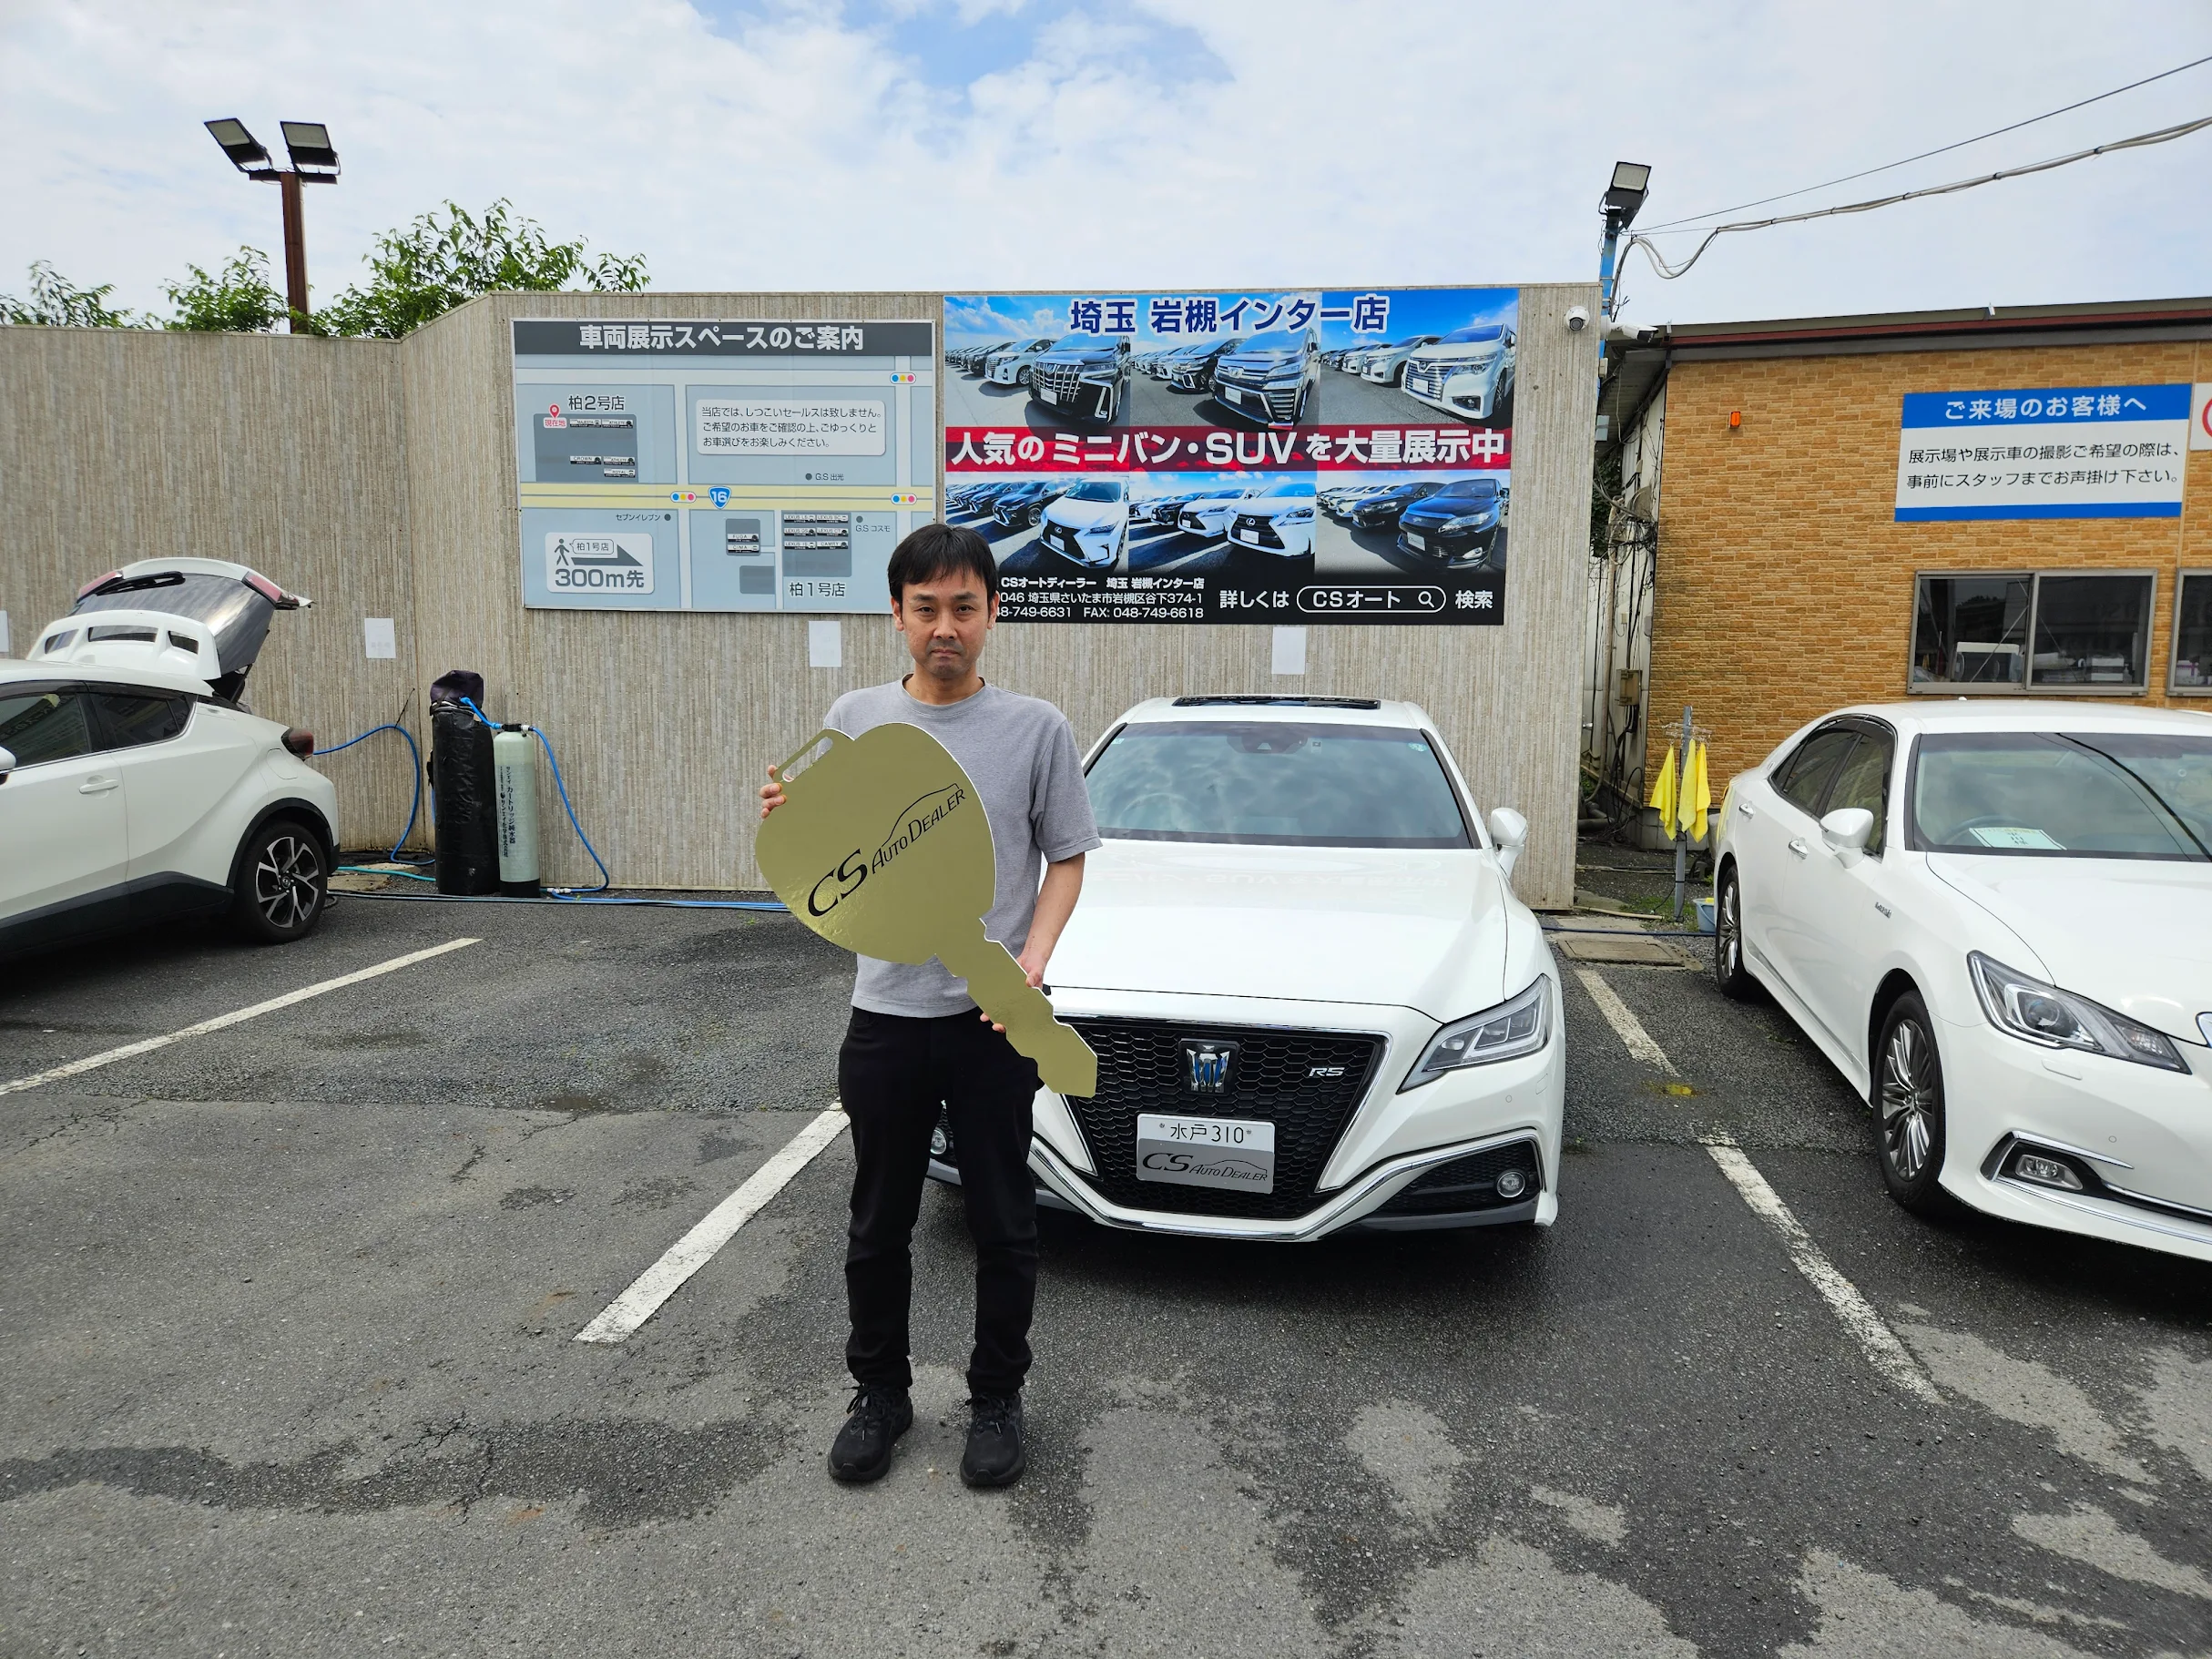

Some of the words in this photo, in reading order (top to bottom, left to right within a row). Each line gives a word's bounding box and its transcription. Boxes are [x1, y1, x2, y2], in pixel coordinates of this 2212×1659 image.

[1070, 301, 1137, 333] 埼玉
[1151, 296, 1389, 333] 岩槻インター店
[579, 324, 864, 351] 車両展示スペースのご案内
[568, 395, 625, 411] 柏2号店
[1945, 393, 2146, 420] ご来場のお客様へ
[701, 406, 882, 418] 当店では、しつこいセールスは致しません。
[545, 419, 566, 427] 現在地
[703, 422, 877, 433] ご希望のお車をご確認の上、ごゆっくりと
[703, 437, 830, 448] お車選びをお楽しみください。
[952, 433, 1045, 465] 人気の
[1054, 431, 1297, 465] ミニバン・SUV
[1306, 429, 1506, 465] を大量展示中
[1909, 442, 2179, 463] 展示場や展示車の撮影ご希望の際は、
[830, 473, 844, 481] 出光
[1907, 469, 2178, 489] 事前にスタッフまでお声掛け下さい。
[711, 491, 728, 504] 16
[576, 542, 609, 552] 柏1号店
[555, 568, 645, 588] 300m先
[1001, 576, 1097, 589] CSオートディーラー
[1106, 577, 1128, 589] 埼玉
[1131, 577, 1205, 590] 岩槻インター店
[790, 582, 846, 597] 柏1号店
[1028, 593, 1203, 605] 埼玉県さいたま市岩槻区谷下374-1
[1219, 590, 1289, 609] 詳しくは
[1312, 590, 1401, 609] CSオート
[1454, 589, 1493, 609] 検索
[1083, 607, 1110, 618] FAX:
[1113, 607, 1204, 618] 048-749-6618
[808, 848, 868, 917] CS
[872, 836, 909, 875] AUTO
[908, 788, 967, 843] DEALER
[1308, 1066, 1345, 1077] RS
[1142, 1152, 1194, 1173] CS
[1189, 1164, 1220, 1177] AUTO
[1221, 1166, 1269, 1182] DEALER
